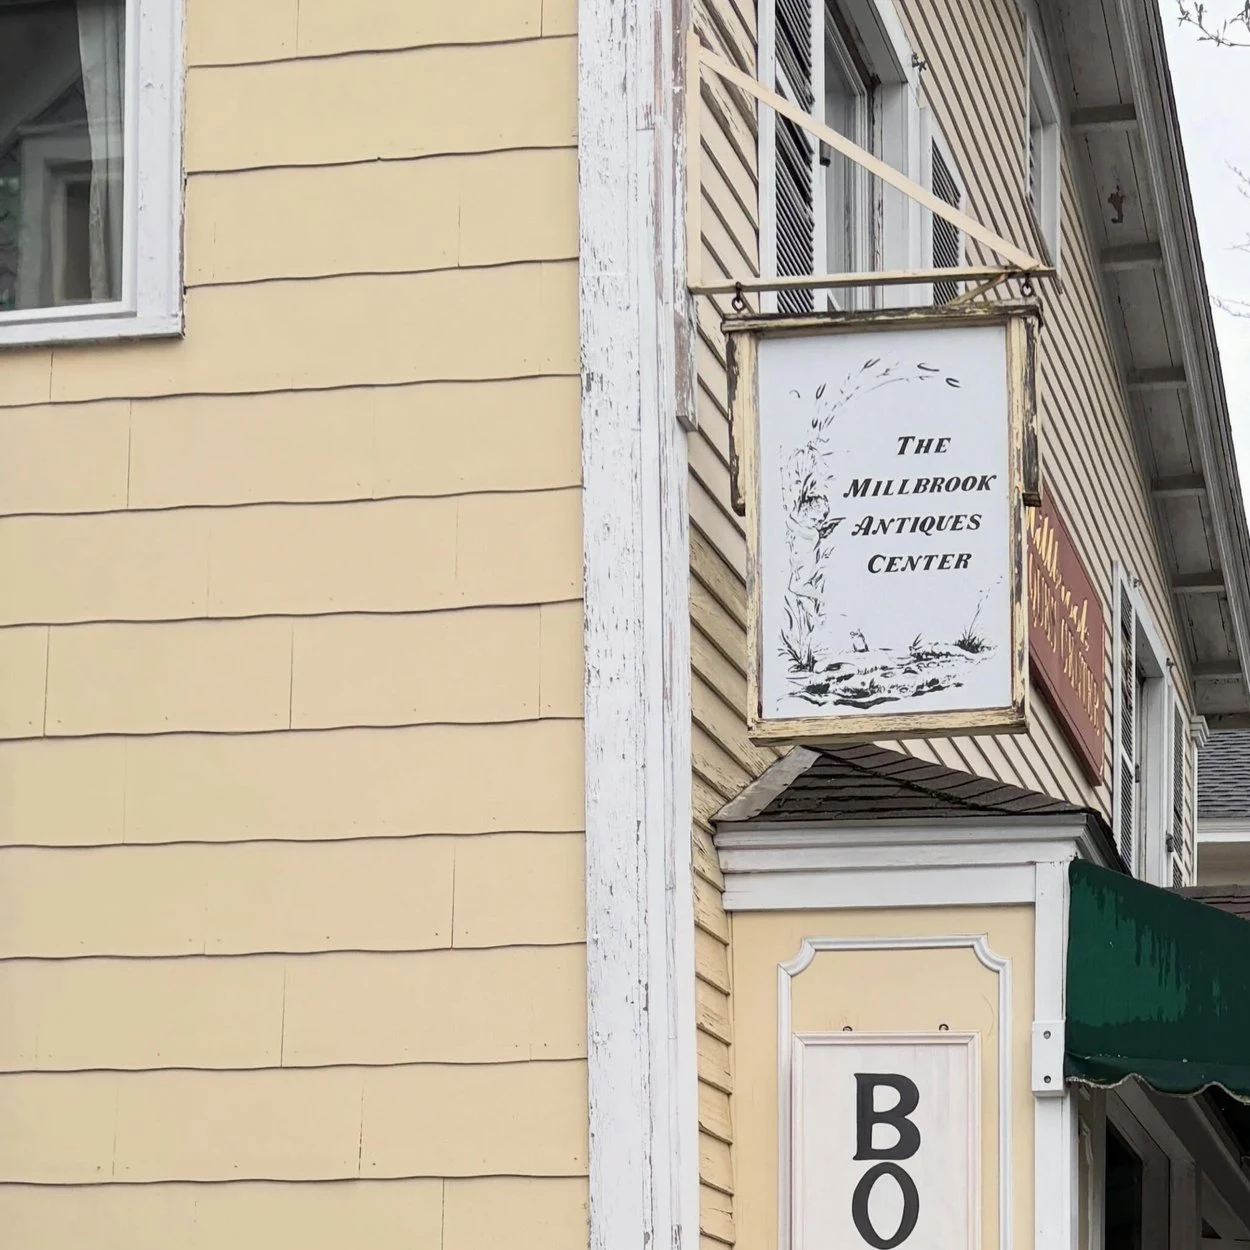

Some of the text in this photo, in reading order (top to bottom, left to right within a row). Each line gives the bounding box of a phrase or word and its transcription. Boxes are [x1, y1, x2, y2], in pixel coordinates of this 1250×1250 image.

[897, 436, 951, 456] THE
[843, 474, 997, 499] MILLBROOK
[851, 513, 982, 537] ANTIQUES
[867, 552, 972, 574] CENTER
